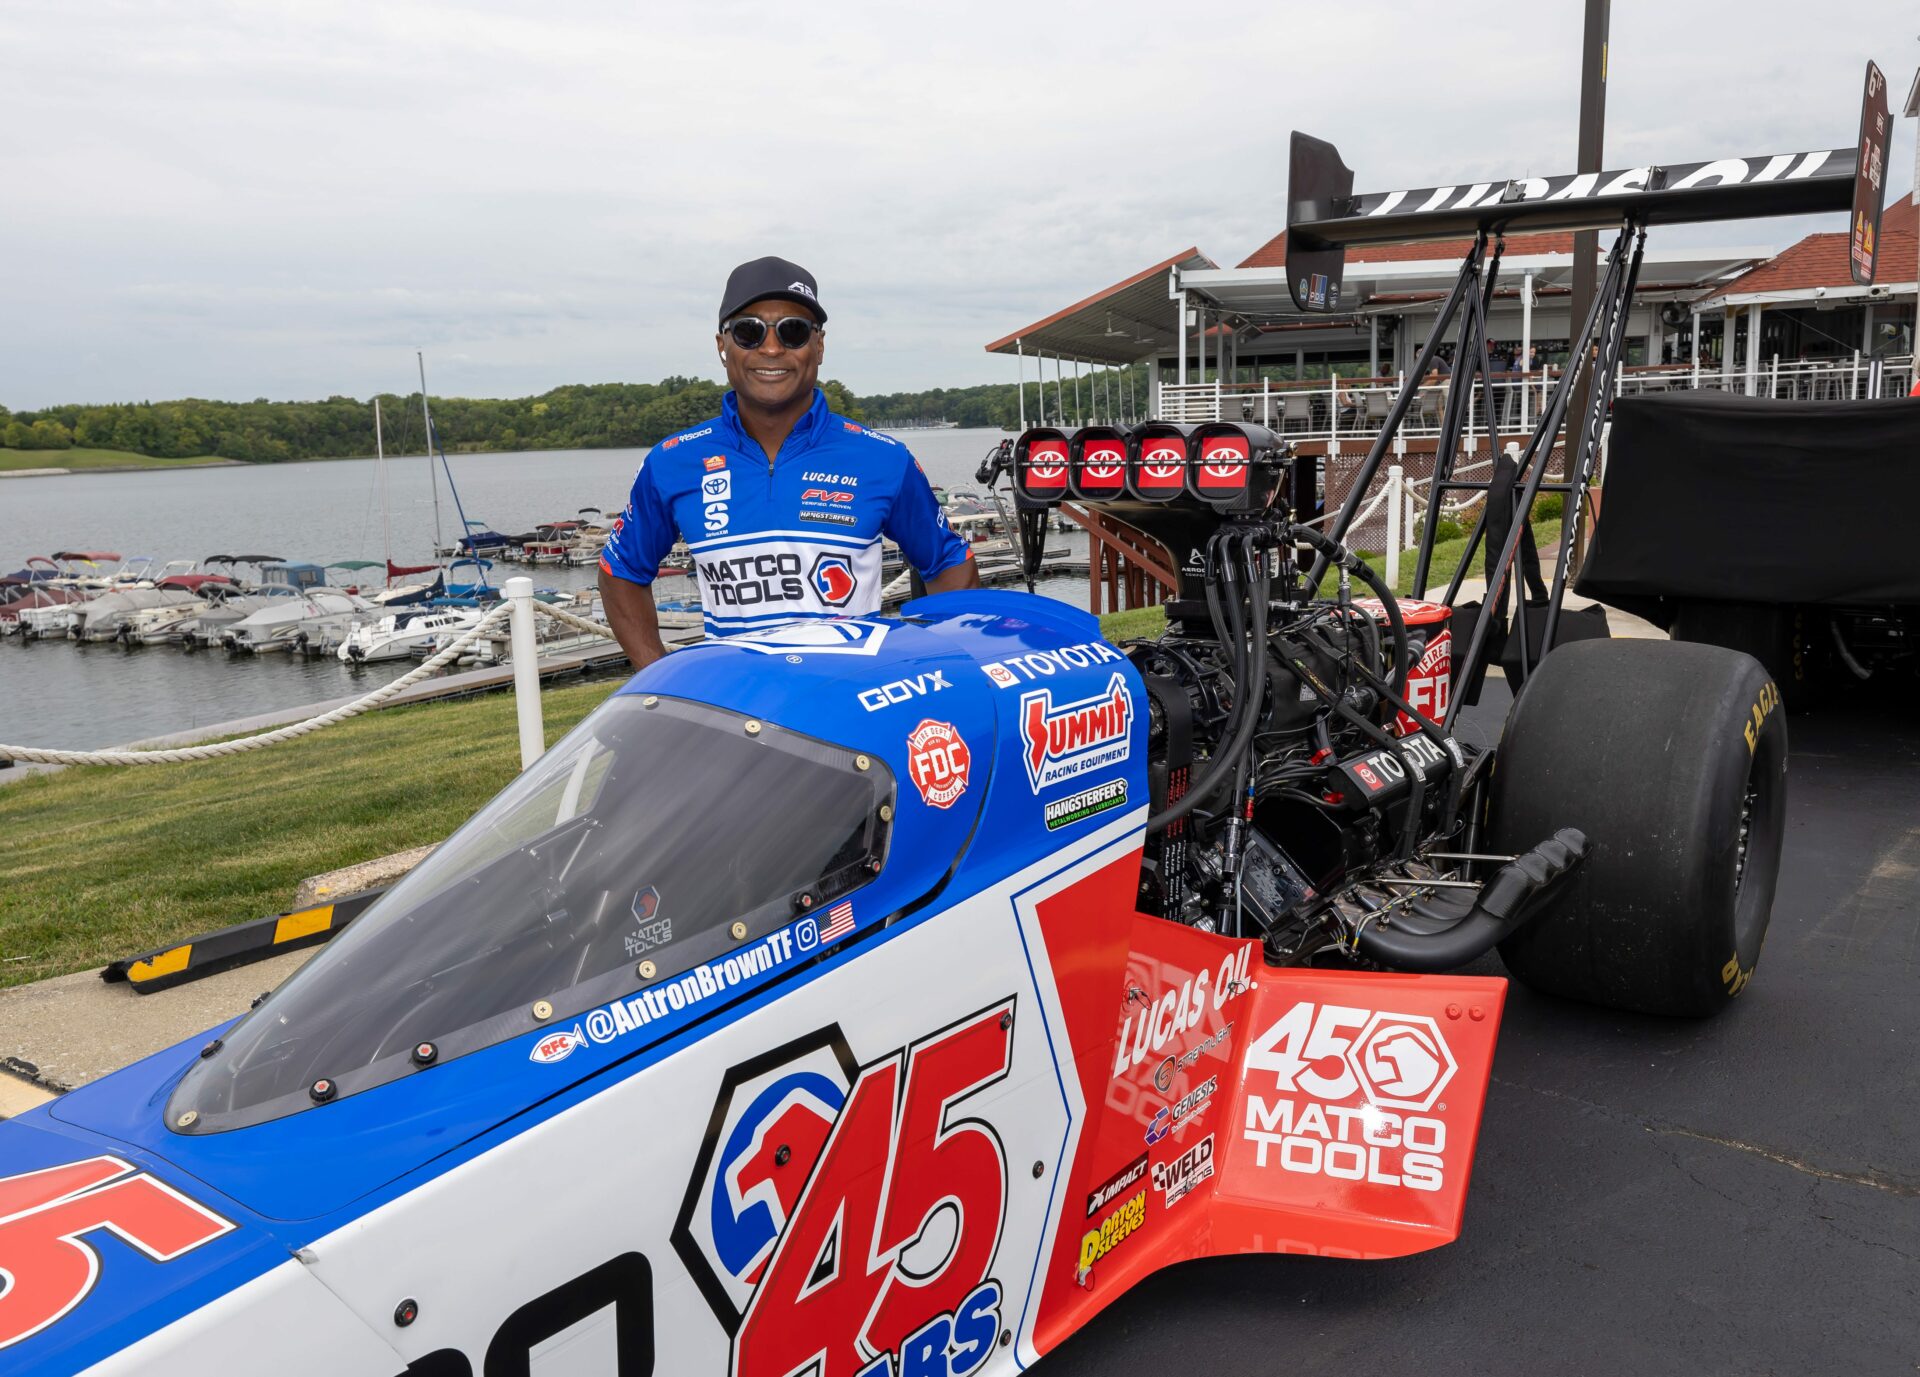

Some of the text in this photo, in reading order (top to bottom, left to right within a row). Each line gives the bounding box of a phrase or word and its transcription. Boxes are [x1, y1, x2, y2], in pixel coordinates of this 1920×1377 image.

[801, 488, 855, 503] FVP
[802, 471, 858, 487] LUCAS OIL
[699, 553, 802, 582] MATCO
[710, 577, 804, 606] TOOLS
[1005, 642, 1122, 680] TOYOTA
[1421, 645, 1443, 670] FIRE
[857, 670, 954, 712] GOVX
[916, 730, 929, 746] FIRE
[914, 742, 966, 786] FDC
[1044, 746, 1128, 782] RACING EQUIPMENT
[934, 785, 959, 801] COFFEE
[1045, 780, 1126, 821] HANGSTERFER'S
[1049, 807, 1090, 829] METALWORKING
[624, 918, 671, 947] MATCO
[625, 929, 673, 957] TOOLS
[586, 929, 793, 1044] @AntronBrownTF
[1113, 968, 1210, 1079] LUCAS
[541, 1037, 569, 1057] RFC
[1246, 1001, 1371, 1100] 45
[1172, 1075, 1217, 1121] GENESIS
[1245, 1095, 1447, 1154] MATCO
[1166, 1137, 1213, 1191] WELD
[1243, 1129, 1444, 1192] TOOLS
[728, 995, 1016, 1377] 45
[1079, 1189, 1147, 1271] DARTON
[1097, 1208, 1146, 1260] SLEEVES
